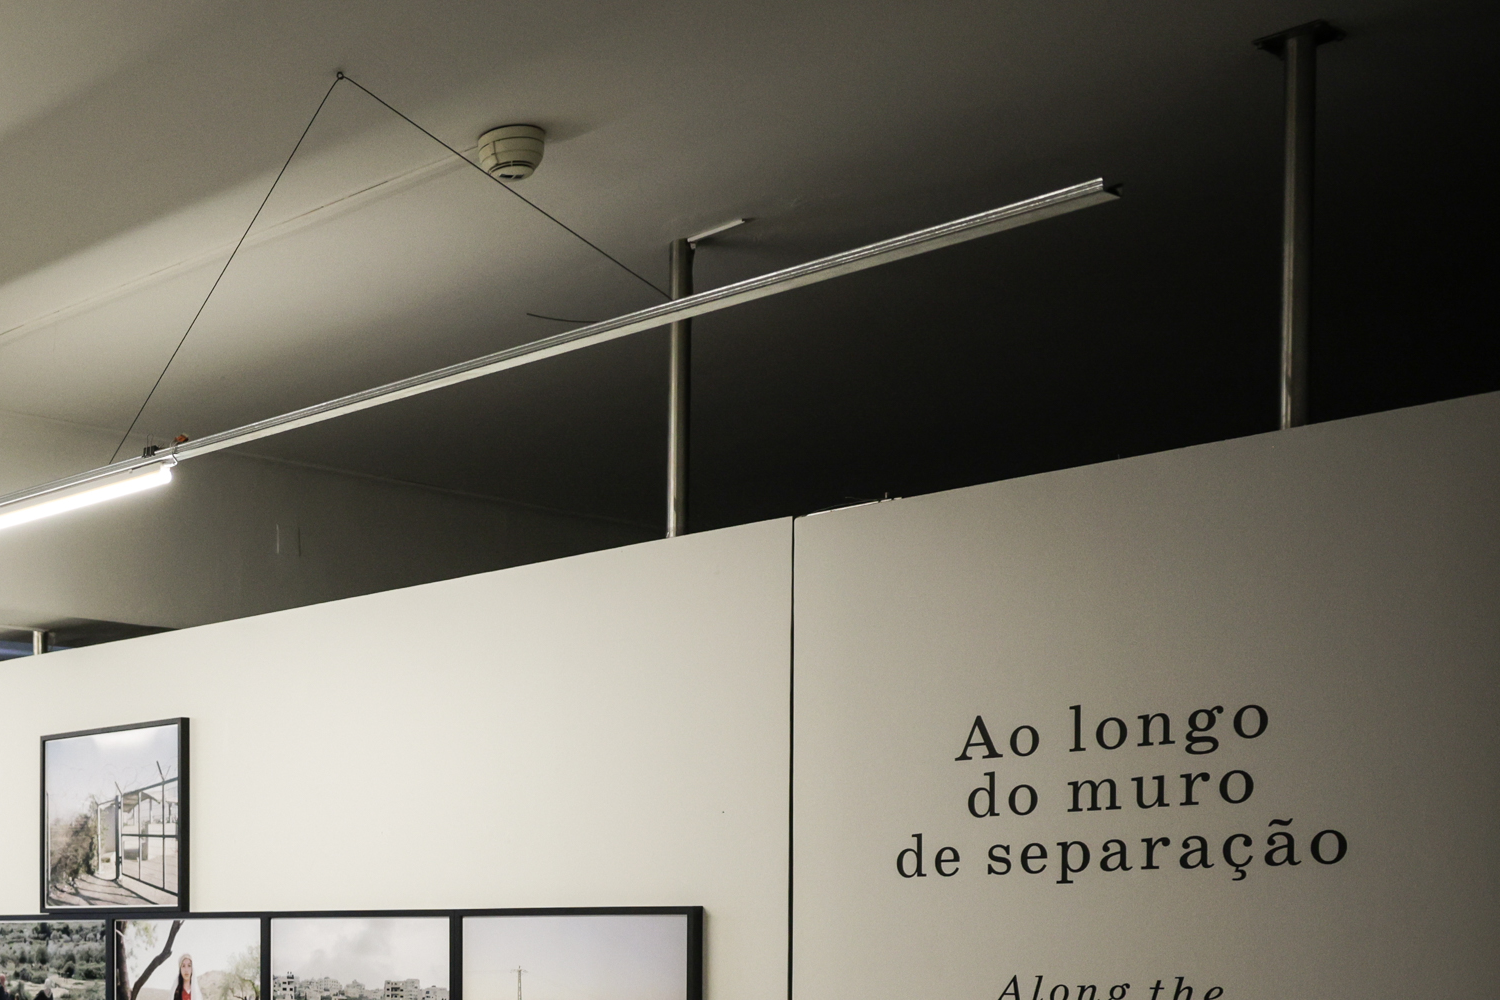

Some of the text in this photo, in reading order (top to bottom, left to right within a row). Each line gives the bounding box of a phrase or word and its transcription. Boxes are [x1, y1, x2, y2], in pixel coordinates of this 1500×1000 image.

[955, 703, 1269, 761] Ao longo
[967, 768, 1255, 818] do muro
[896, 818, 1348, 884] de separação
